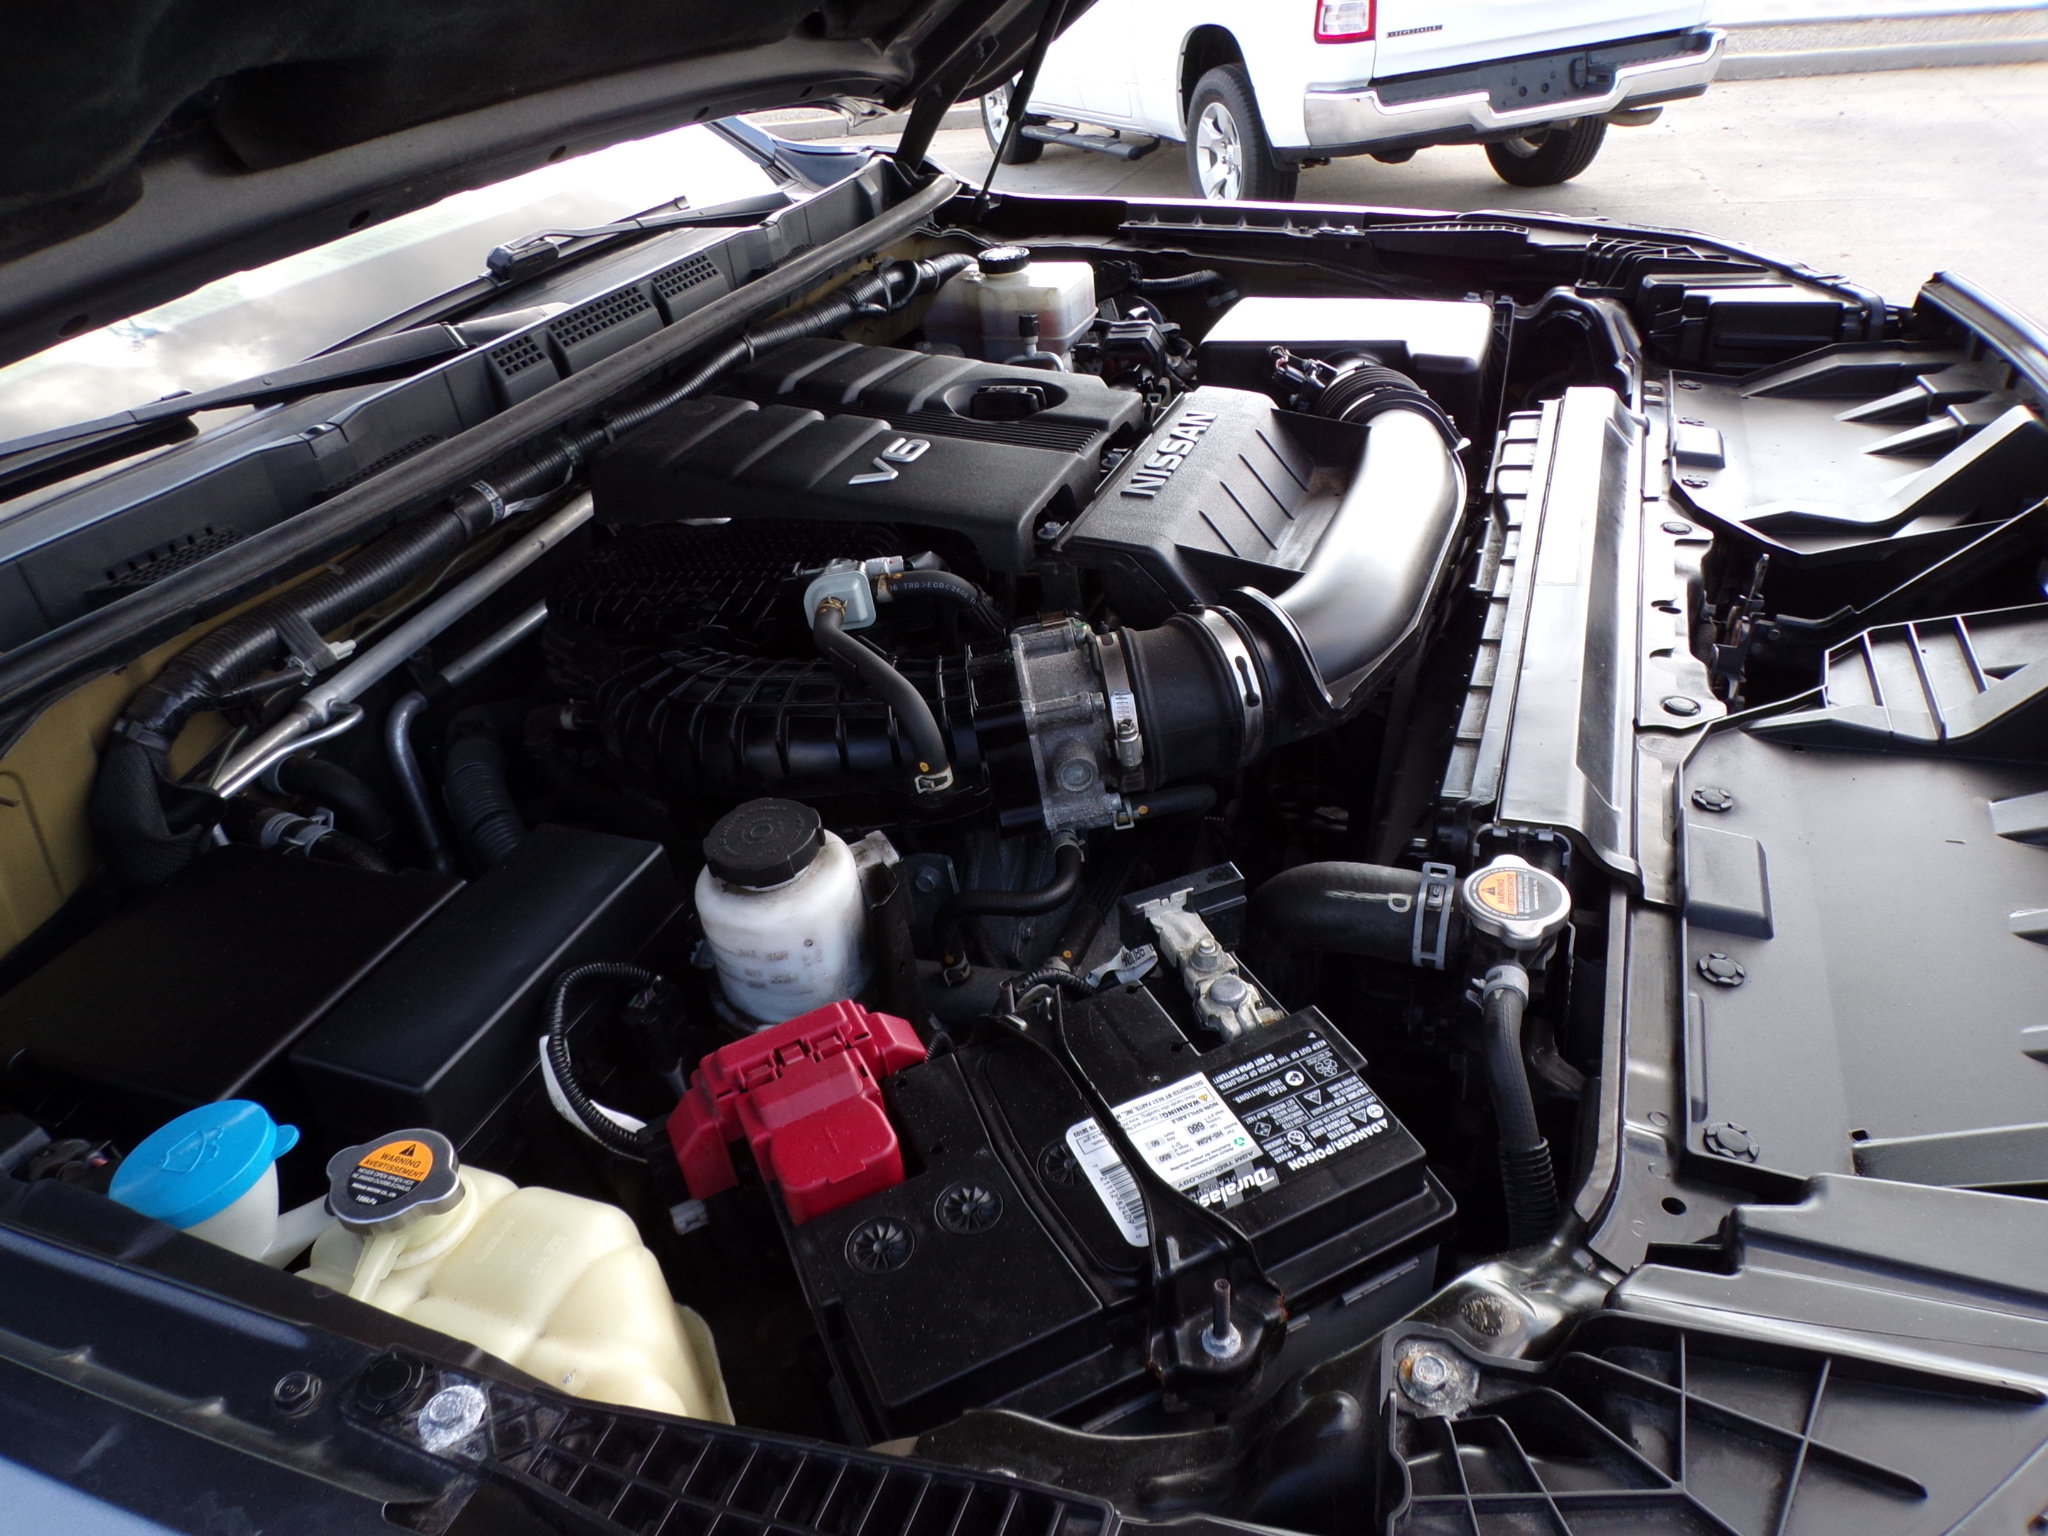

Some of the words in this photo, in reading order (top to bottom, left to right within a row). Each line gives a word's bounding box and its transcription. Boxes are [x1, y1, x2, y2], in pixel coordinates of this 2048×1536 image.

[848, 437, 930, 484] V6
[1120, 411, 1218, 498] NISSAN
[1298, 1046, 1311, 1056] OUT
[1311, 1039, 1327, 1051] KEEP
[1253, 1057, 1266, 1067] NOT
[1265, 1053, 1274, 1062] DO
[1277, 1056, 1290, 1066] THE
[1290, 1051, 1299, 1060] OF
[1239, 1062, 1255, 1073] OPEN
[1248, 1070, 1258, 1078] OF
[1257, 1061, 1278, 1074] REACH
[1172, 1080, 1203, 1096] DISTRIBUTED
[1233, 1079, 1282, 1103] INSTRUCTIONS.
[1268, 1085, 1287, 1097] READ
[1159, 1098, 1200, 1120] WARNING:
[1171, 1101, 1219, 1125] NON-SPILLABLE
[1186, 1120, 1206, 1136] 680
[1287, 1122, 1383, 1170] DANGER/POISON
[1300, 1141, 1314, 1153] NO
[381, 1153, 421, 1168] WARNING
[1234, 1151, 1254, 1163] AGM
[364, 1159, 424, 1178] AVERTISSEMENT
[1178, 1161, 1233, 1188] TECHNOLOGY
[1100, 1175, 1120, 1199] 21112
[1115, 1200, 1135, 1223] 82409
